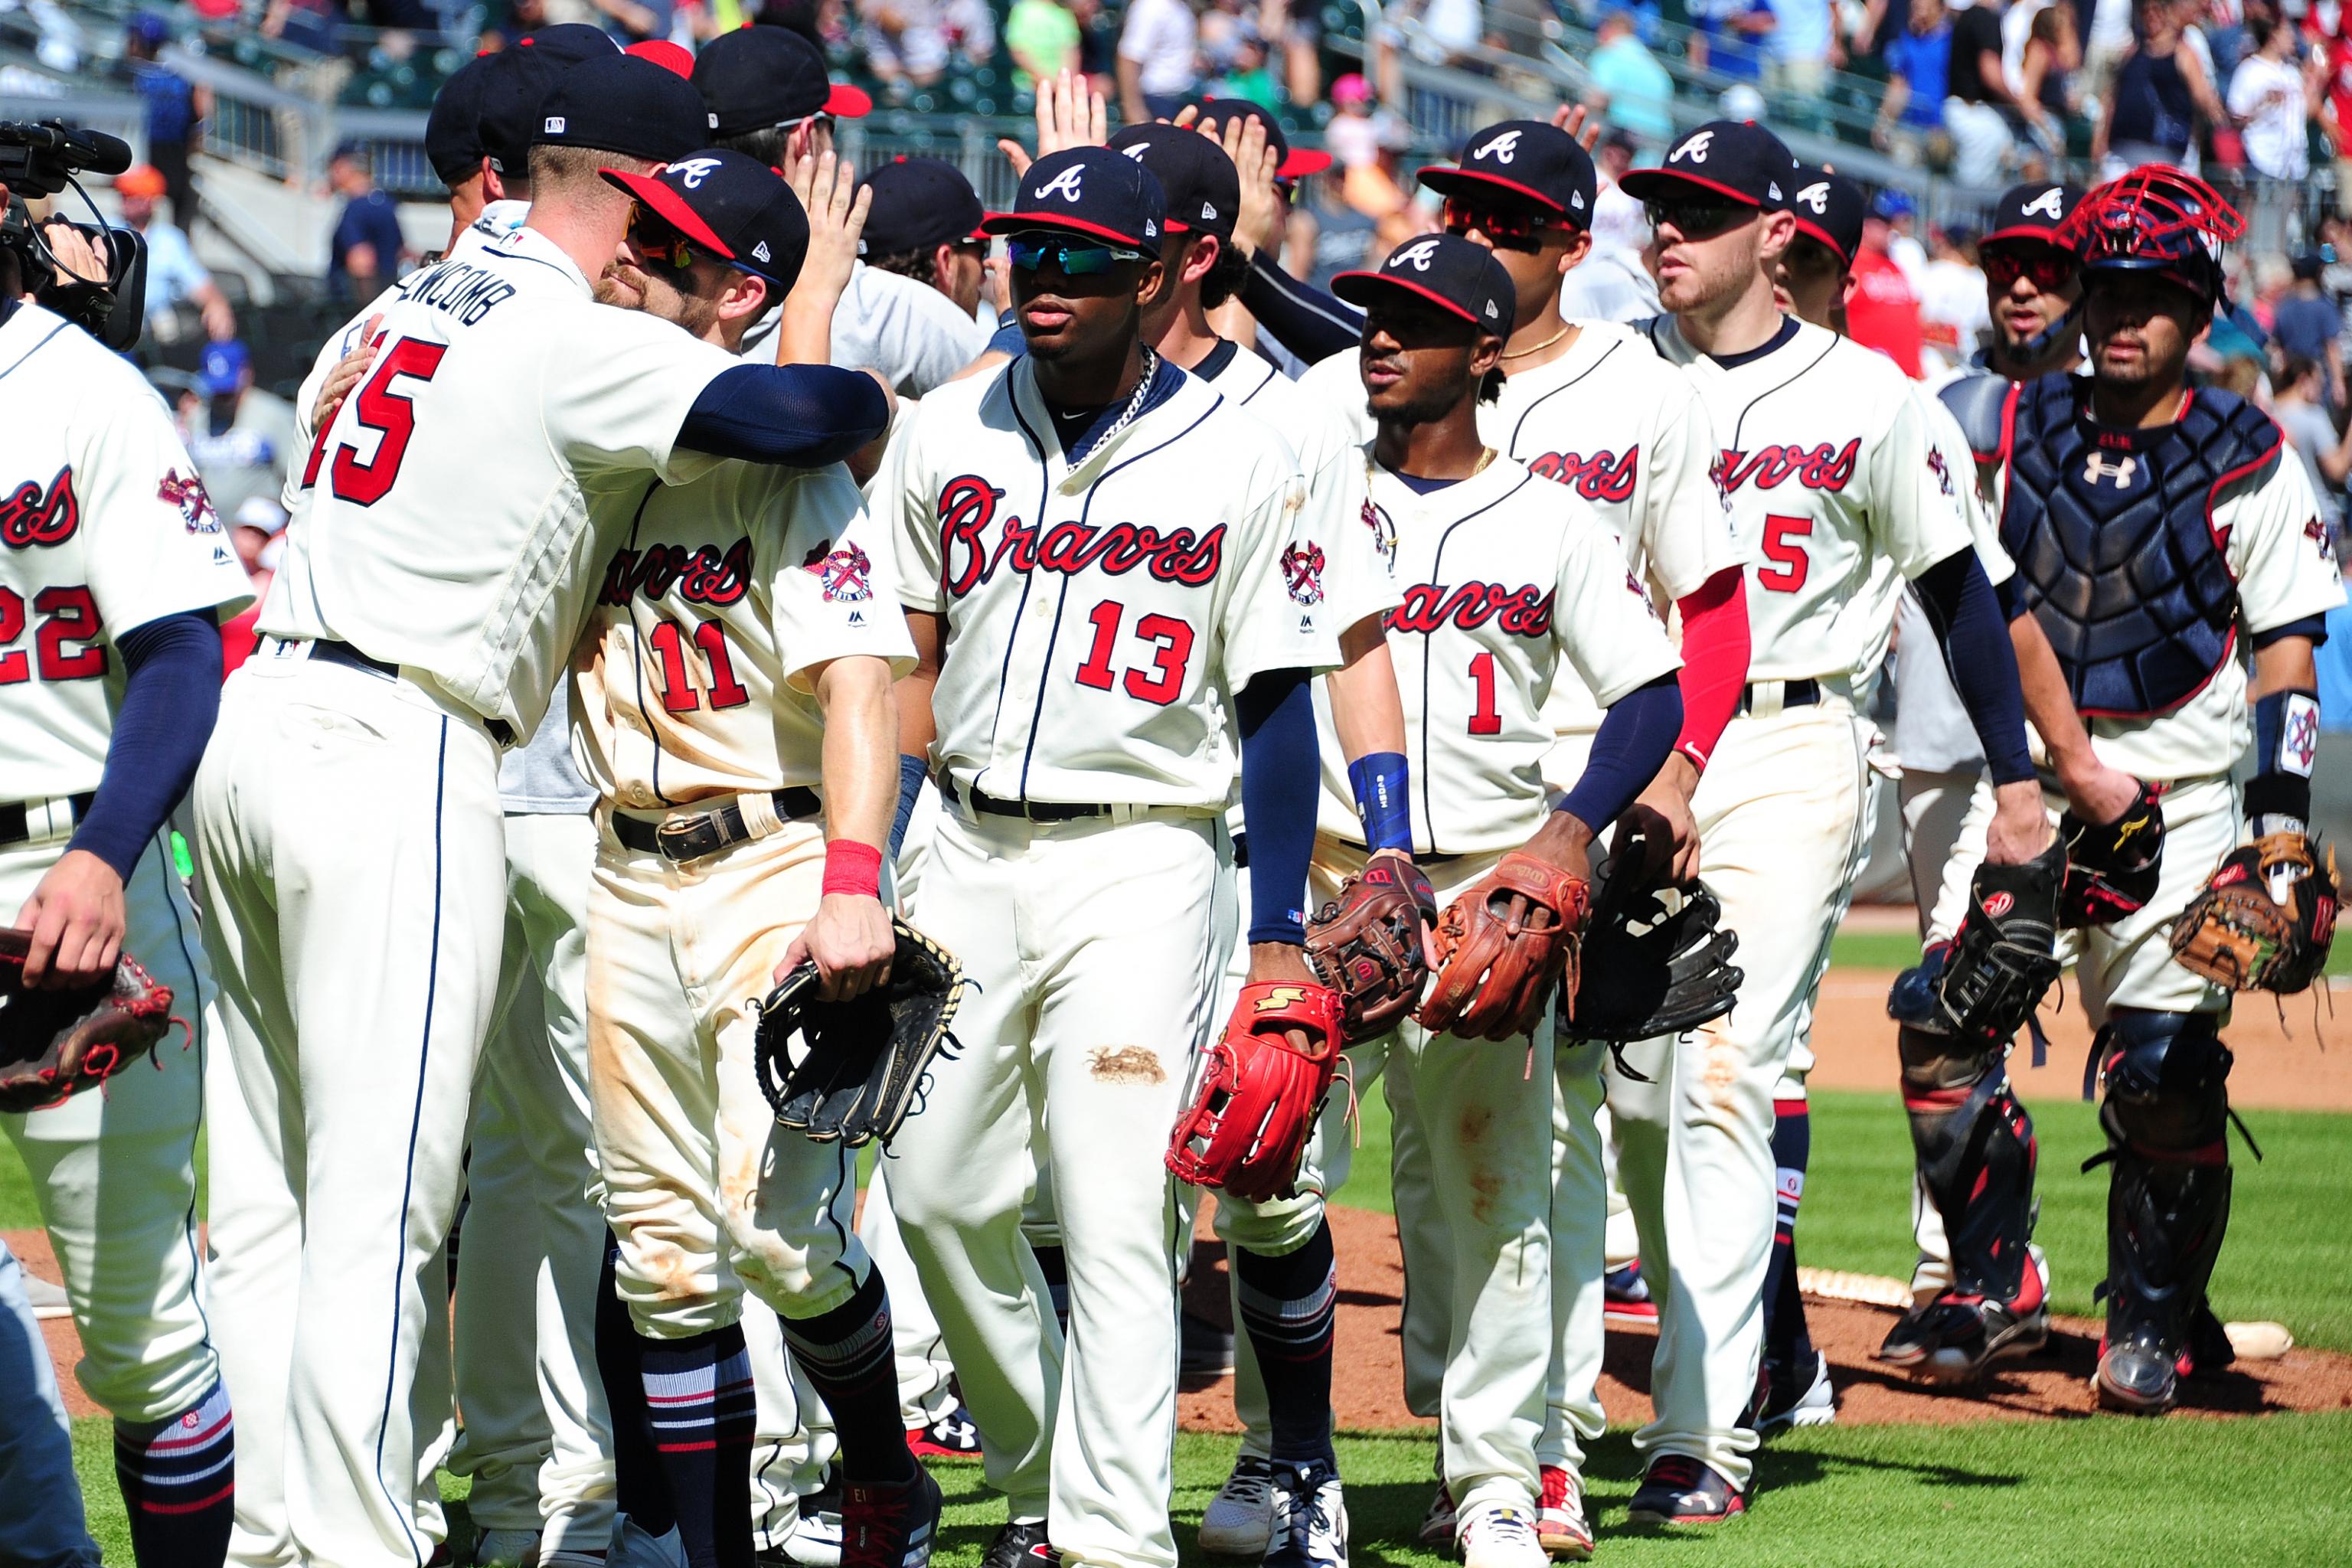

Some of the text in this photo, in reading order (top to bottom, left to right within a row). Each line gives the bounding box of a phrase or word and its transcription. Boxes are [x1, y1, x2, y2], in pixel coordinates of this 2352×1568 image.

[666, 158, 722, 188] A
[1474, 130, 1522, 164] A
[1669, 131, 1714, 163] A
[1035, 164, 1086, 202] A
[1390, 240, 1440, 271] A
[397, 260, 516, 327] EWCOMB
[1527, 444, 1638, 504] ves
[938, 475, 1227, 602] Braves
[1758, 514, 1813, 593] 5
[597, 536, 752, 607] aves
[1383, 580, 1557, 638] aves
[650, 619, 750, 712] 11
[1075, 599, 1195, 706] 13
[1468, 652, 1501, 734] 1
